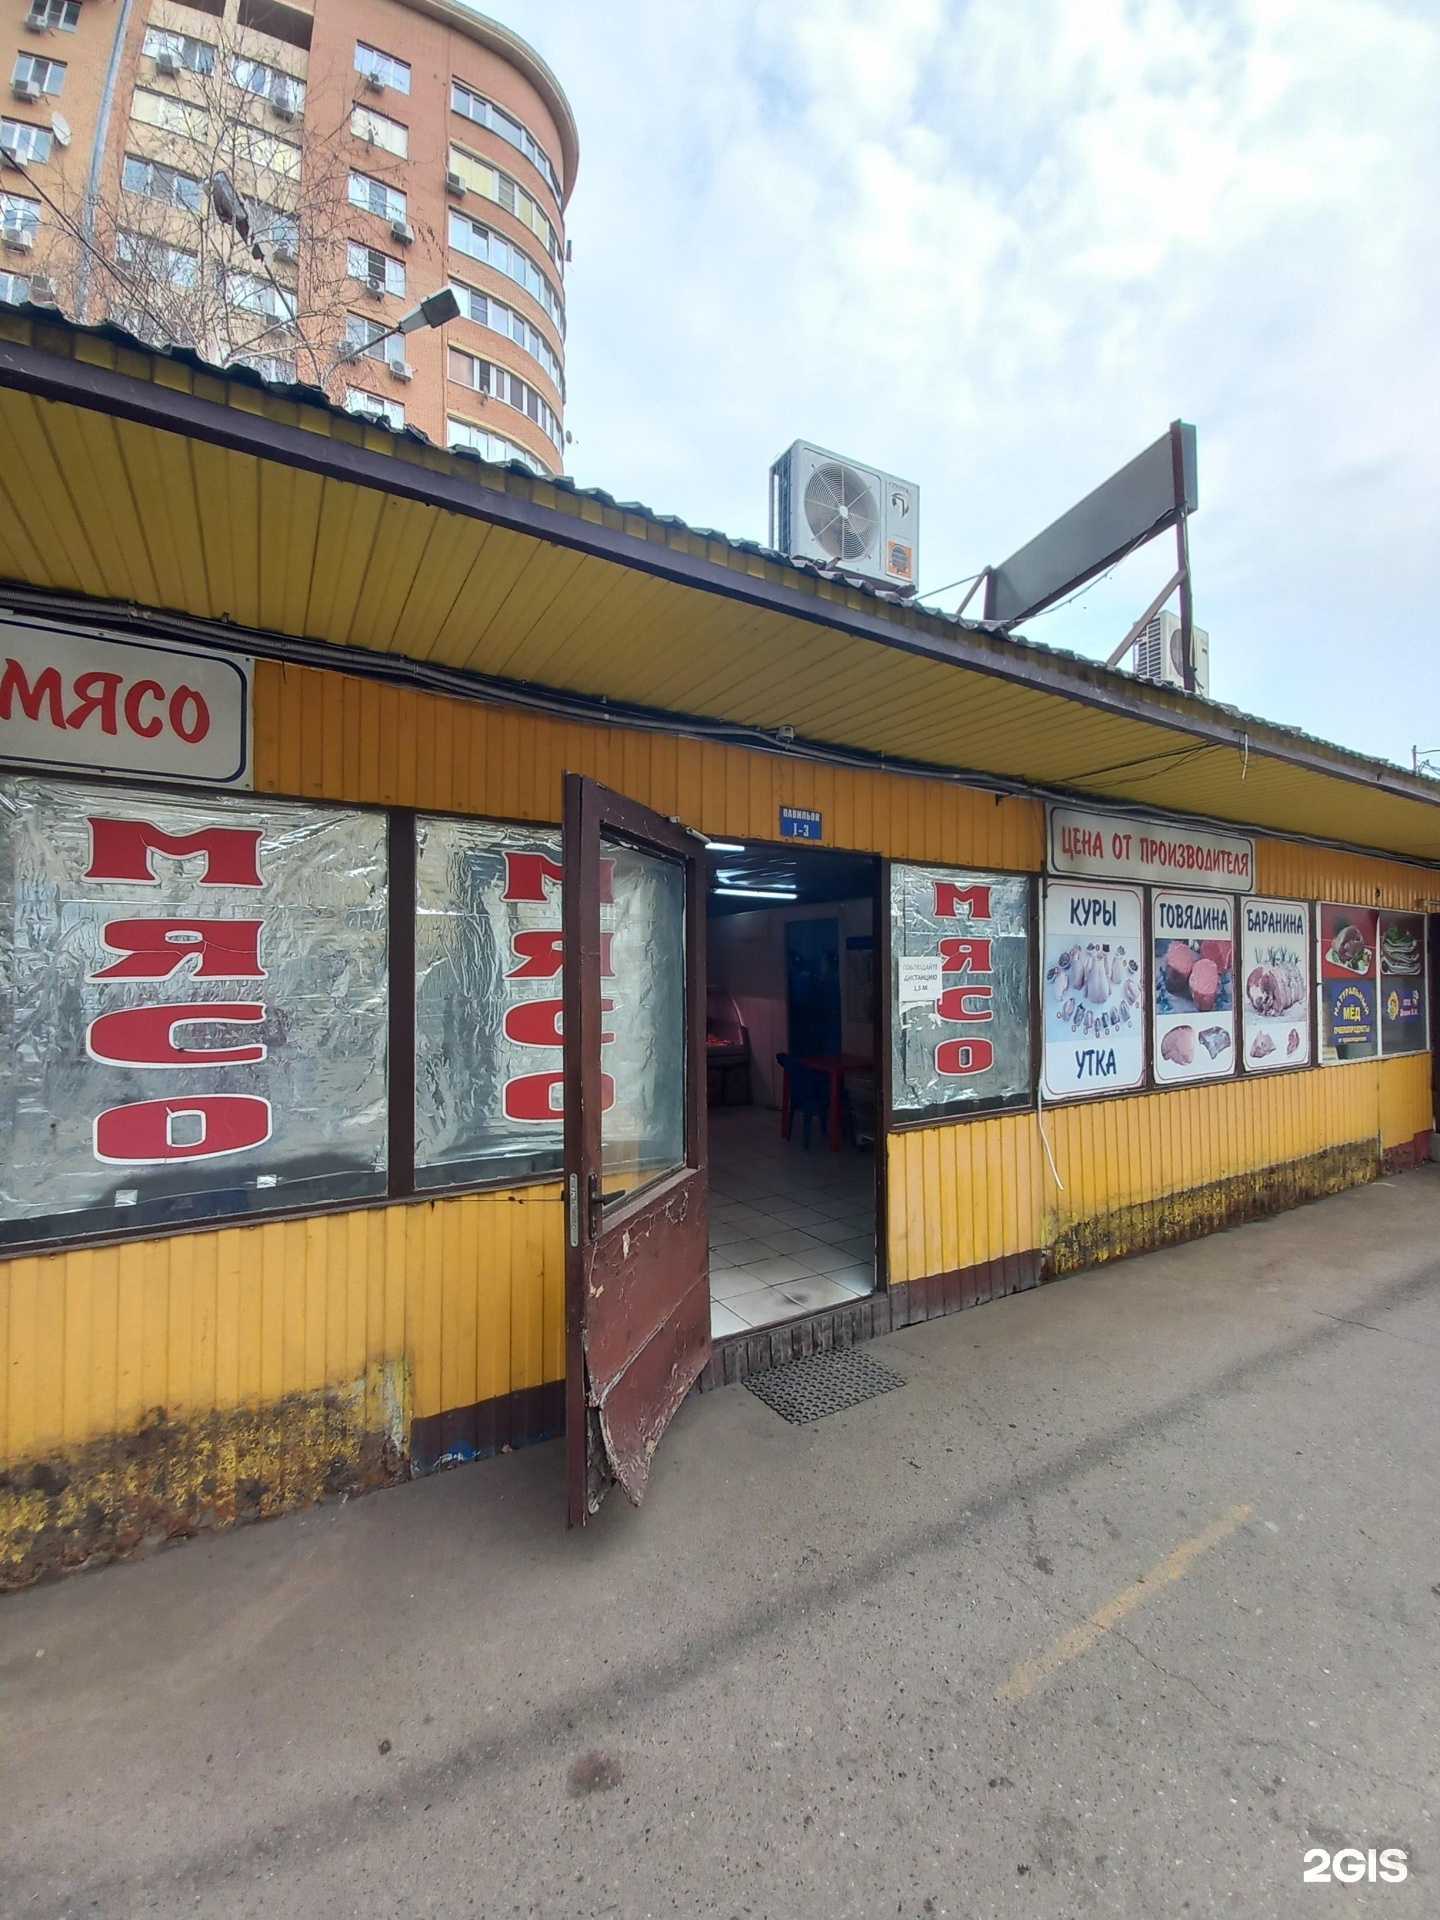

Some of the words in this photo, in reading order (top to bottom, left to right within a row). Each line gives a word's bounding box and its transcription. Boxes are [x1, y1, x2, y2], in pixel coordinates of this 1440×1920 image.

[0, 658, 210, 743] МЯСО
[783, 808, 820, 821] ПАВИЛЬОН
[1061, 826, 1104, 862] ЦЕНА
[1112, 832, 1133, 860] ОТ
[1140, 837, 1249, 876] ПРОИЗВОДИТЕЛЯ
[1070, 898, 1117, 927] КУРЫ
[1160, 903, 1228, 931] ГОВЯДИНА
[1247, 909, 1304, 935] БАРАНИНА
[82, 816, 272, 1165] МЯСО
[932, 881, 994, 1076] МЯСО
[1343, 1003, 1361, 1022] МЁД
[1075, 1048, 1117, 1079] УТКА
